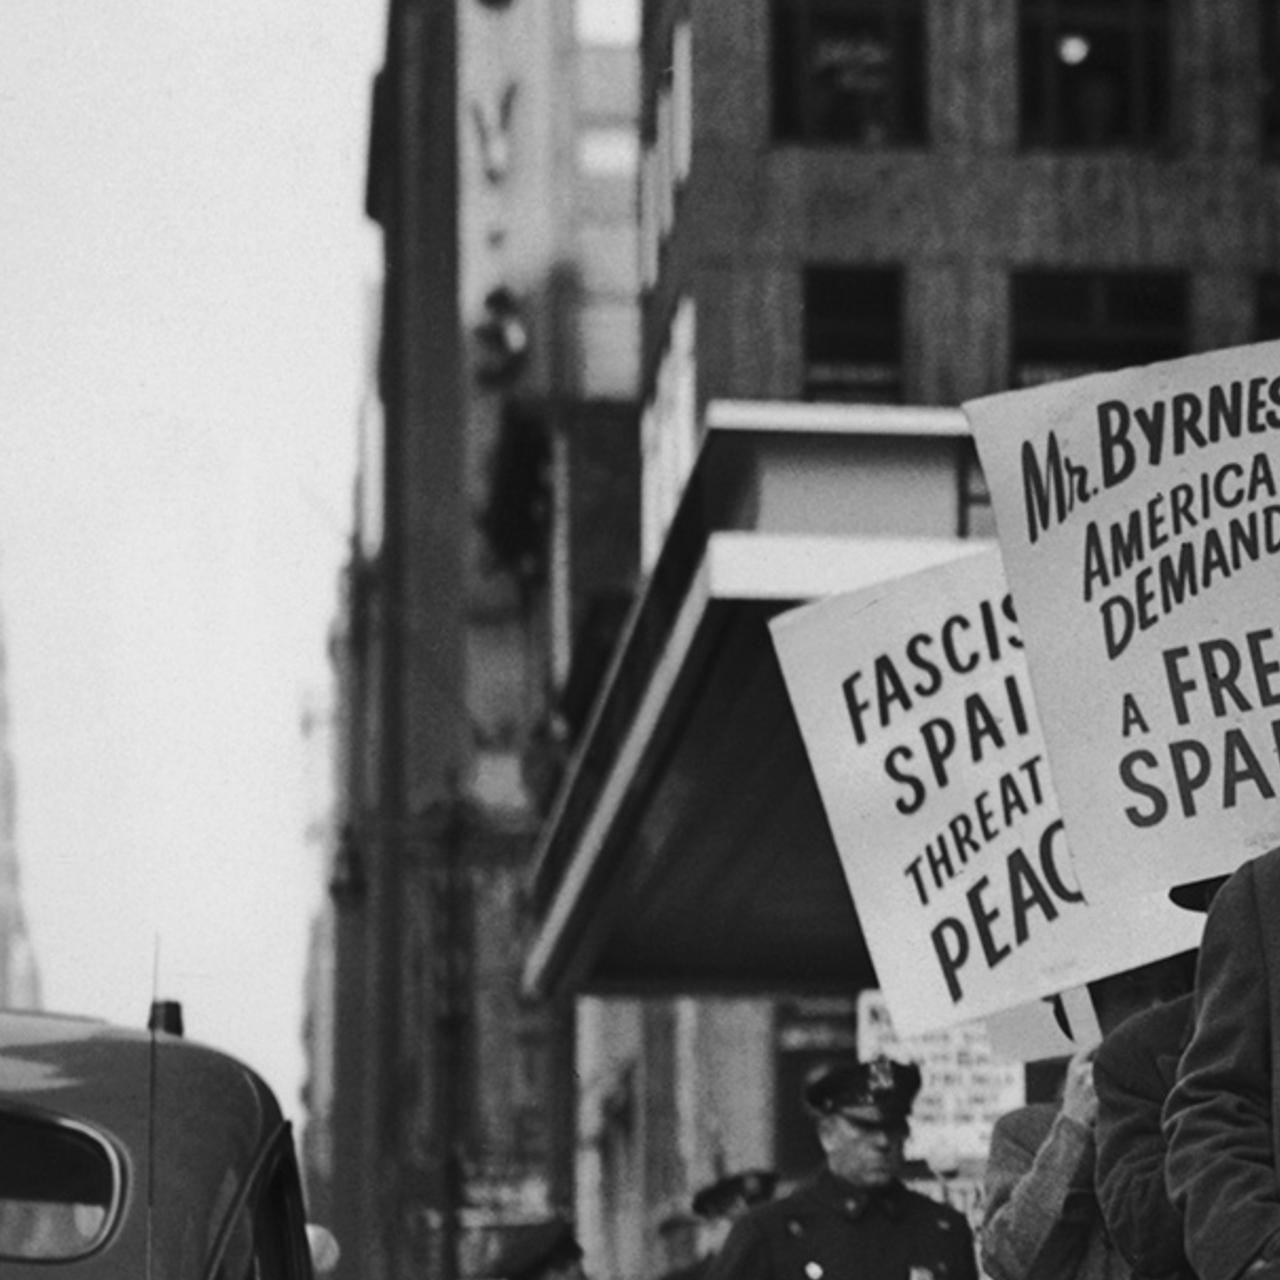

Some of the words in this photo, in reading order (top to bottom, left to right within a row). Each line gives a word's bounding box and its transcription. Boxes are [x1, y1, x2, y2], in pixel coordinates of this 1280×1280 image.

[1020, 429, 1099, 545] Mr.
[1082, 451, 1278, 603] AMERICA
[883, 674, 1029, 816] SPAI
[1121, 692, 1151, 738] A
[903, 754, 1044, 907] THREAT
[930, 817, 1086, 1004] PEAC
